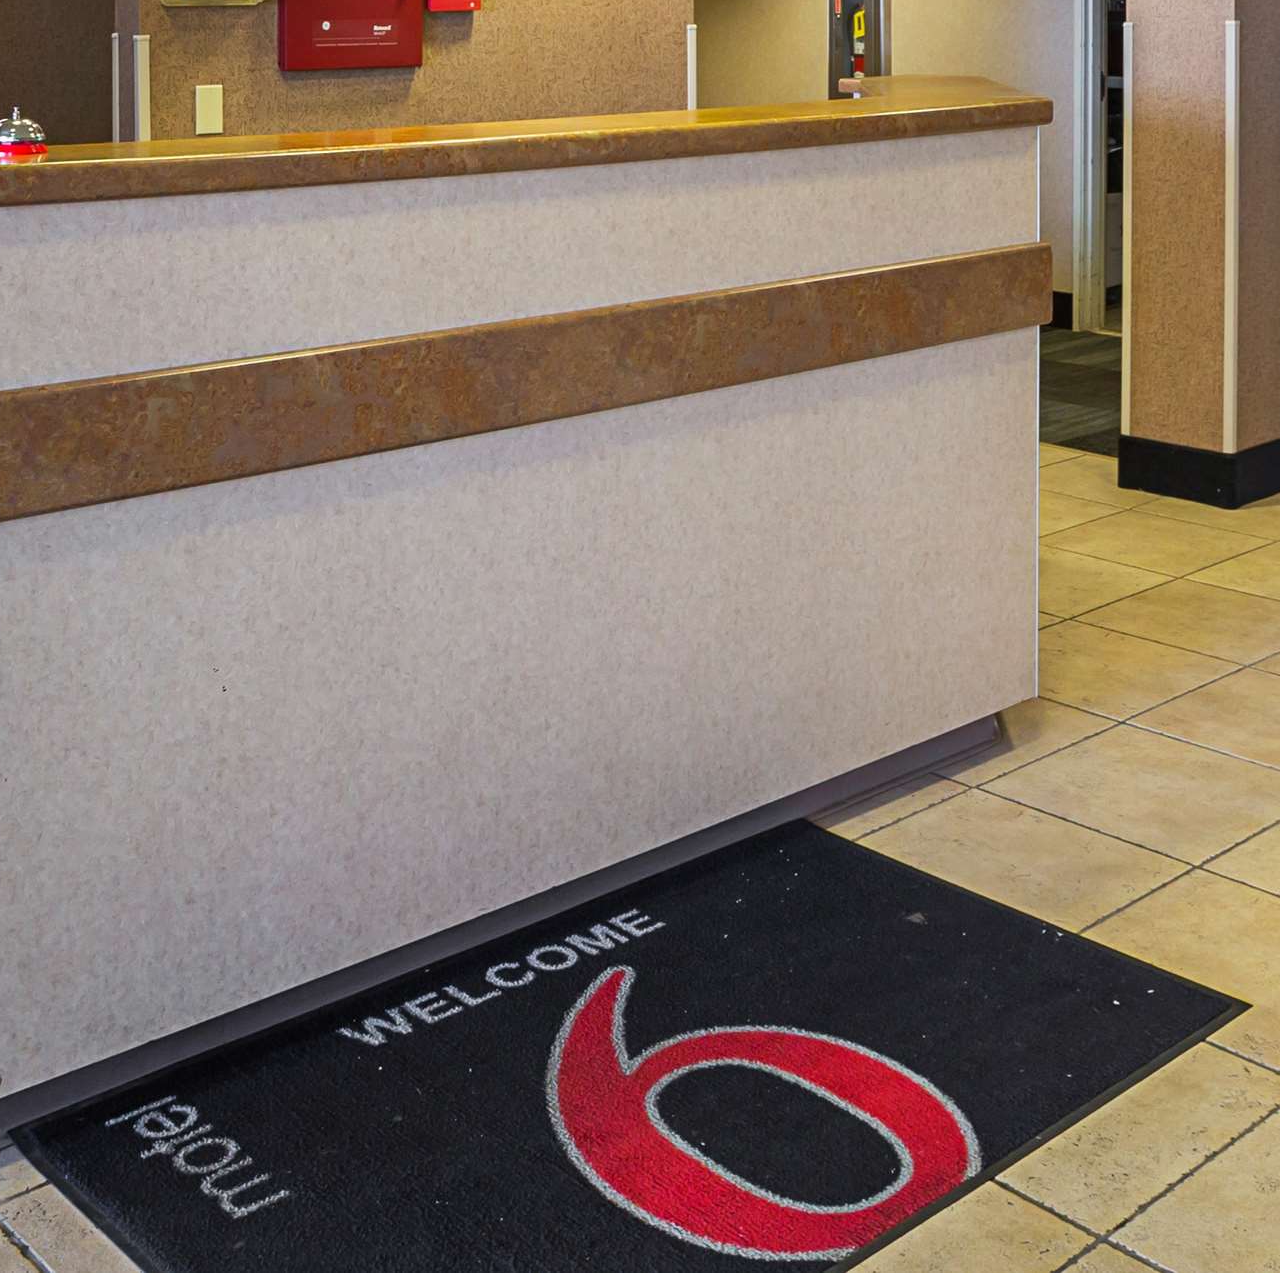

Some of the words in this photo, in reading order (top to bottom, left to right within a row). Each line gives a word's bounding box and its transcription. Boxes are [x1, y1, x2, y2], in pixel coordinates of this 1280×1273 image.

[336, 908, 666, 1046] WELCOME
[105, 1095, 291, 1219] motel
[545, 965, 982, 1262] 6
